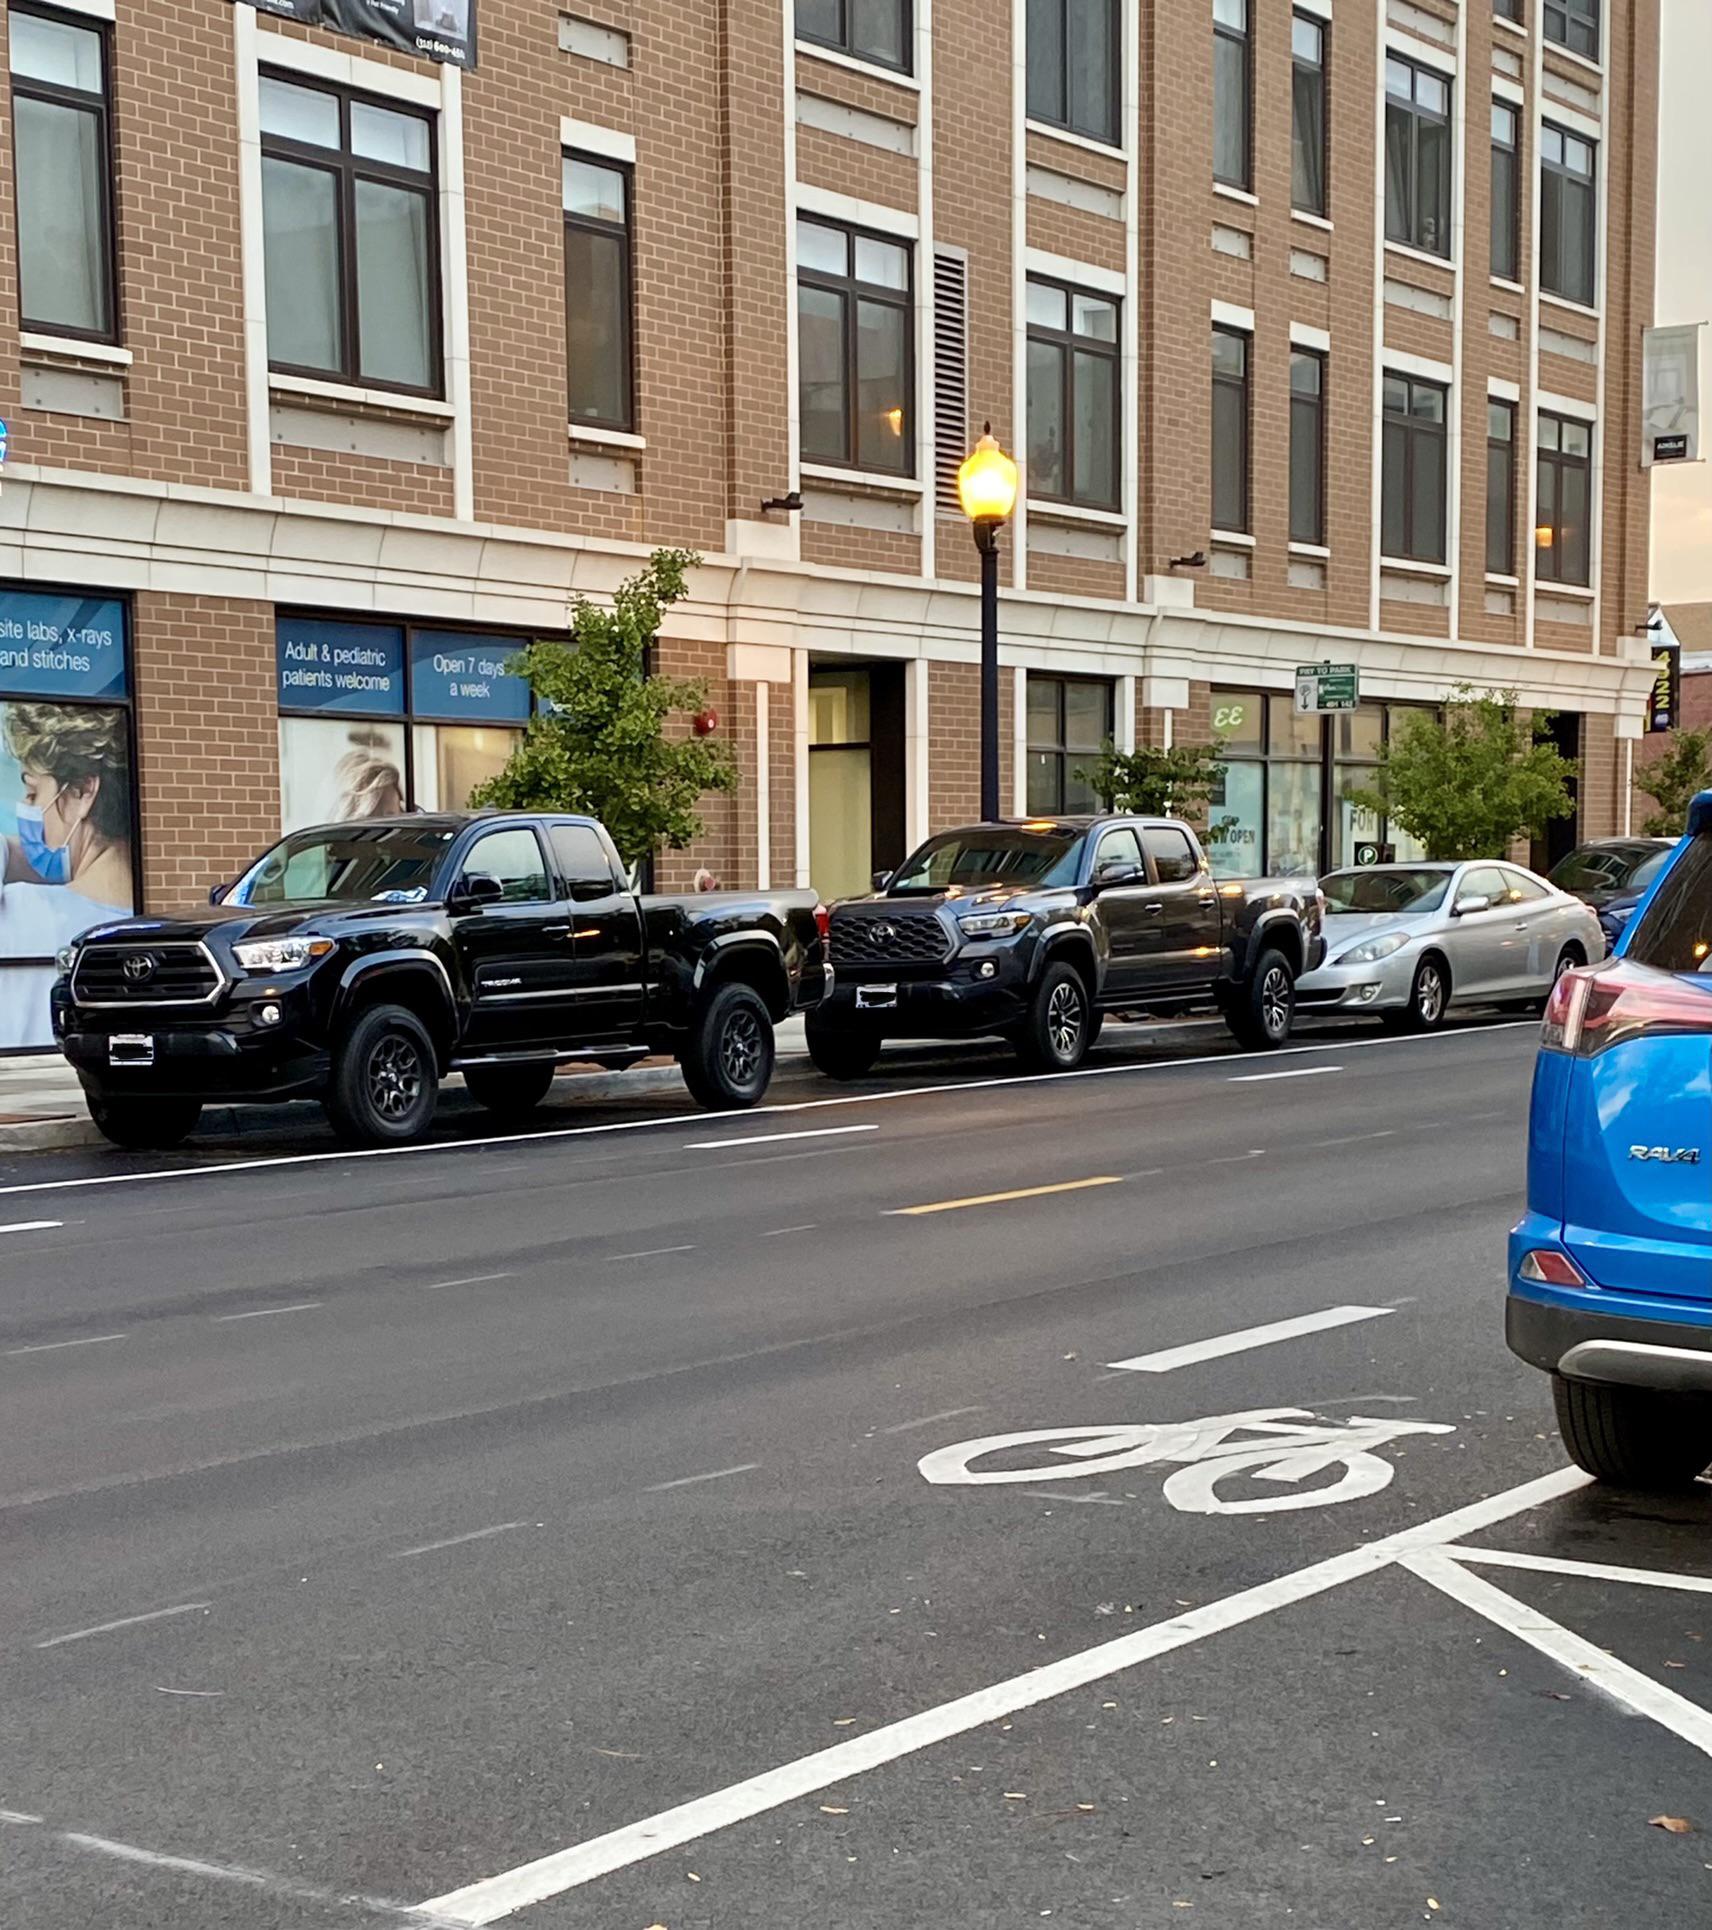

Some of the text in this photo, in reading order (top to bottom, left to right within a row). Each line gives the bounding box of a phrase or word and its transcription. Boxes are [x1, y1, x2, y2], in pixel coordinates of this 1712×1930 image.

[27, 620, 62, 643] labs,
[66, 627, 112, 649] x-rays
[0, 648, 90, 671] and stitches
[285, 641, 386, 667] Adult & pediatric
[433, 654, 505, 679] Open 7 days
[1316, 667, 1328, 675] TO
[1329, 666, 1352, 674] PARK
[282, 668, 390, 691] patients welcome
[450, 682, 490, 698] a week
[1230, 829, 1255, 844] OPEN
[1627, 1145, 1700, 1163] RAV4
